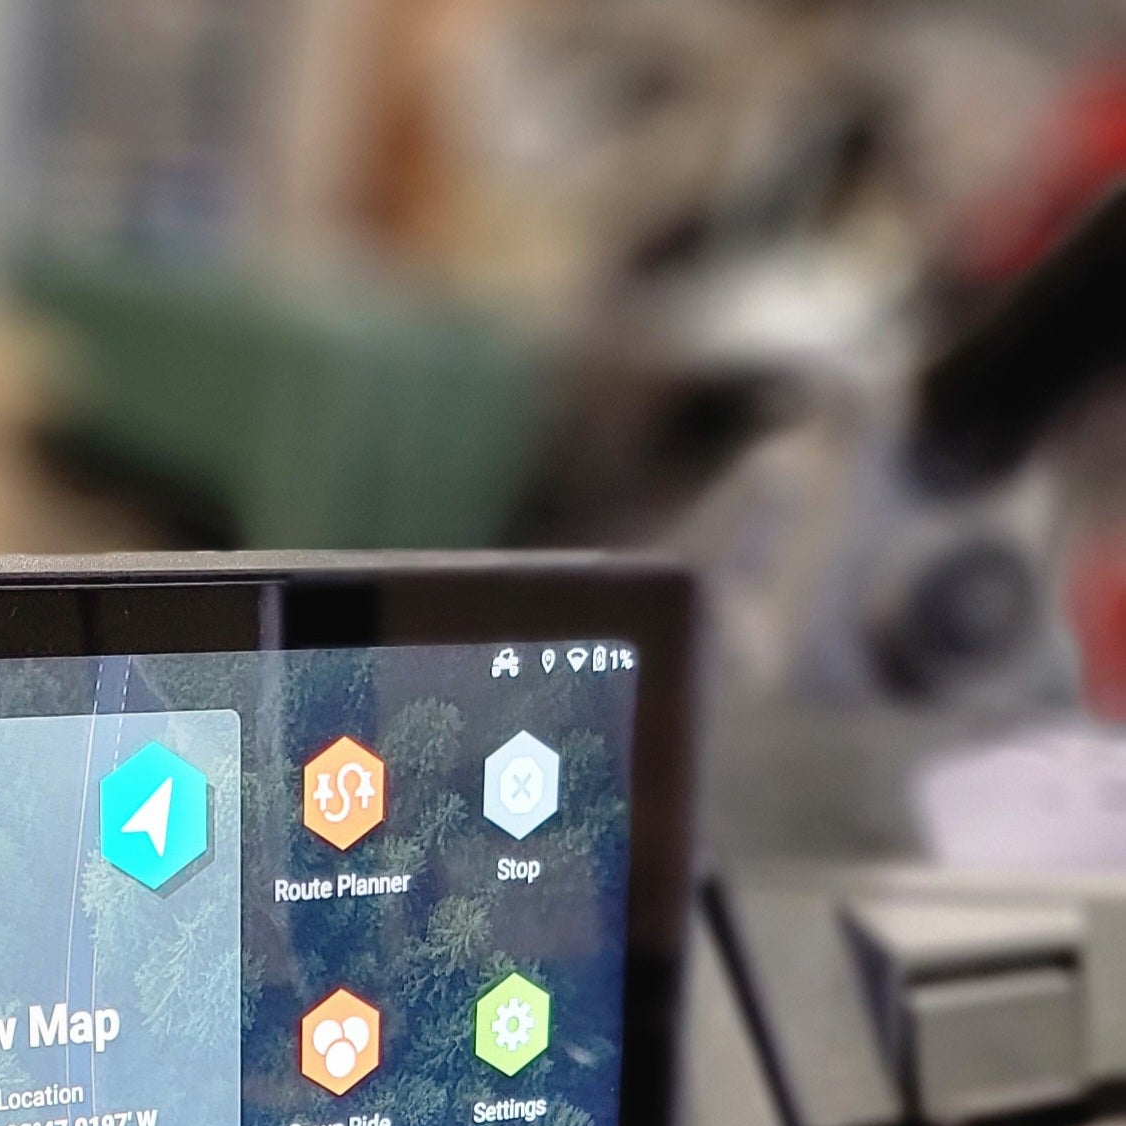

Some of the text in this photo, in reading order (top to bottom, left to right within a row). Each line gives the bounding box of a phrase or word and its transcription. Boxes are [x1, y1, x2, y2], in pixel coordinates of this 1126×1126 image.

[610, 648, 634, 671] 1%
[497, 857, 540, 883] Stop
[274, 872, 411, 902] Route Planner
[28, 1002, 121, 1053] Map
[473, 1096, 547, 1124] Settings
